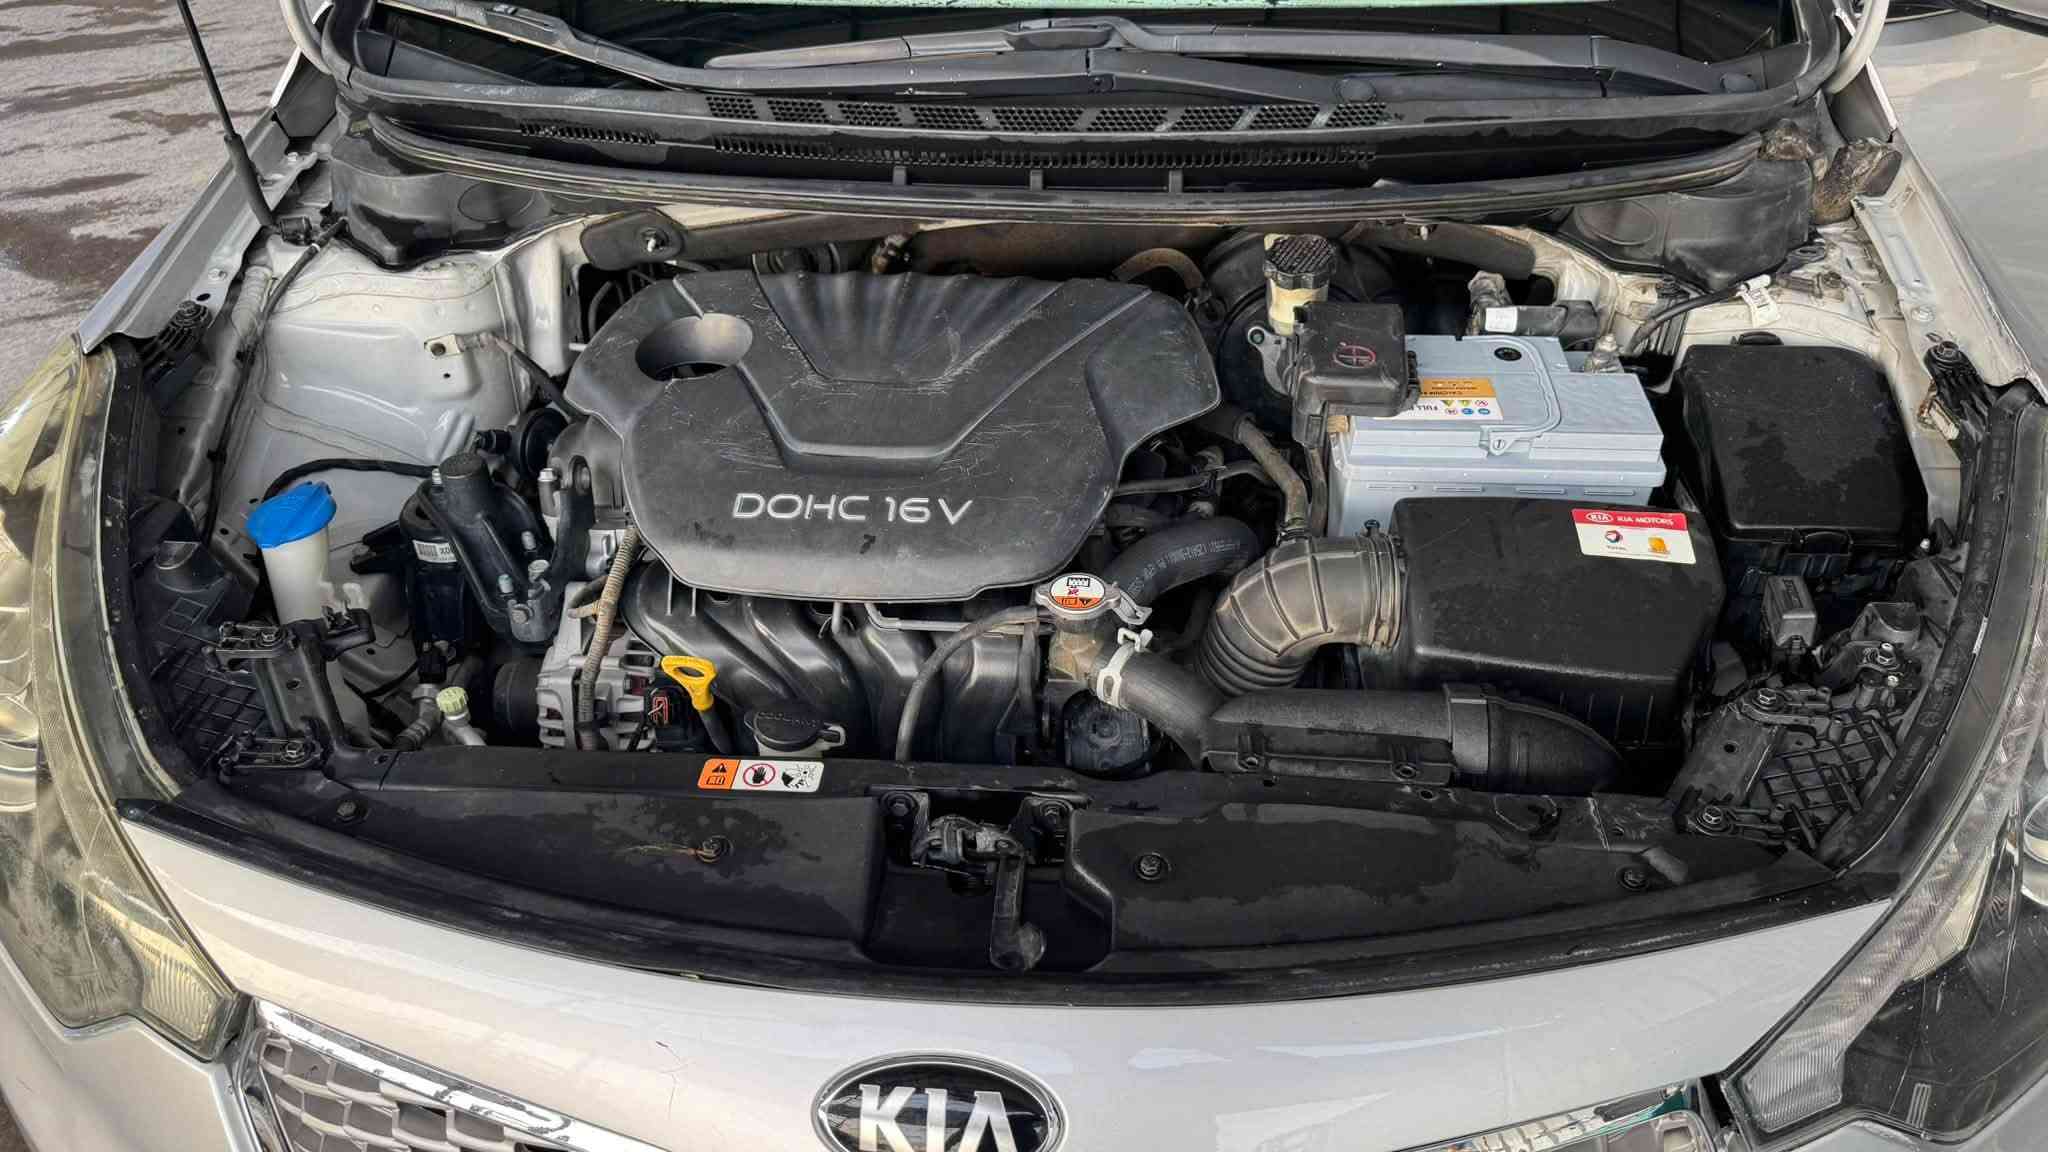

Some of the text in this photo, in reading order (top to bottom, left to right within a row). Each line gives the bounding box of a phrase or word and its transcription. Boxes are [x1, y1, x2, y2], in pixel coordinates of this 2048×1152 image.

[732, 492, 870, 521] DOHC
[1589, 512, 1610, 522] KIA
[1616, 515, 1674, 526] KIA MOTORS
[859, 1084, 1018, 1152] KIA
